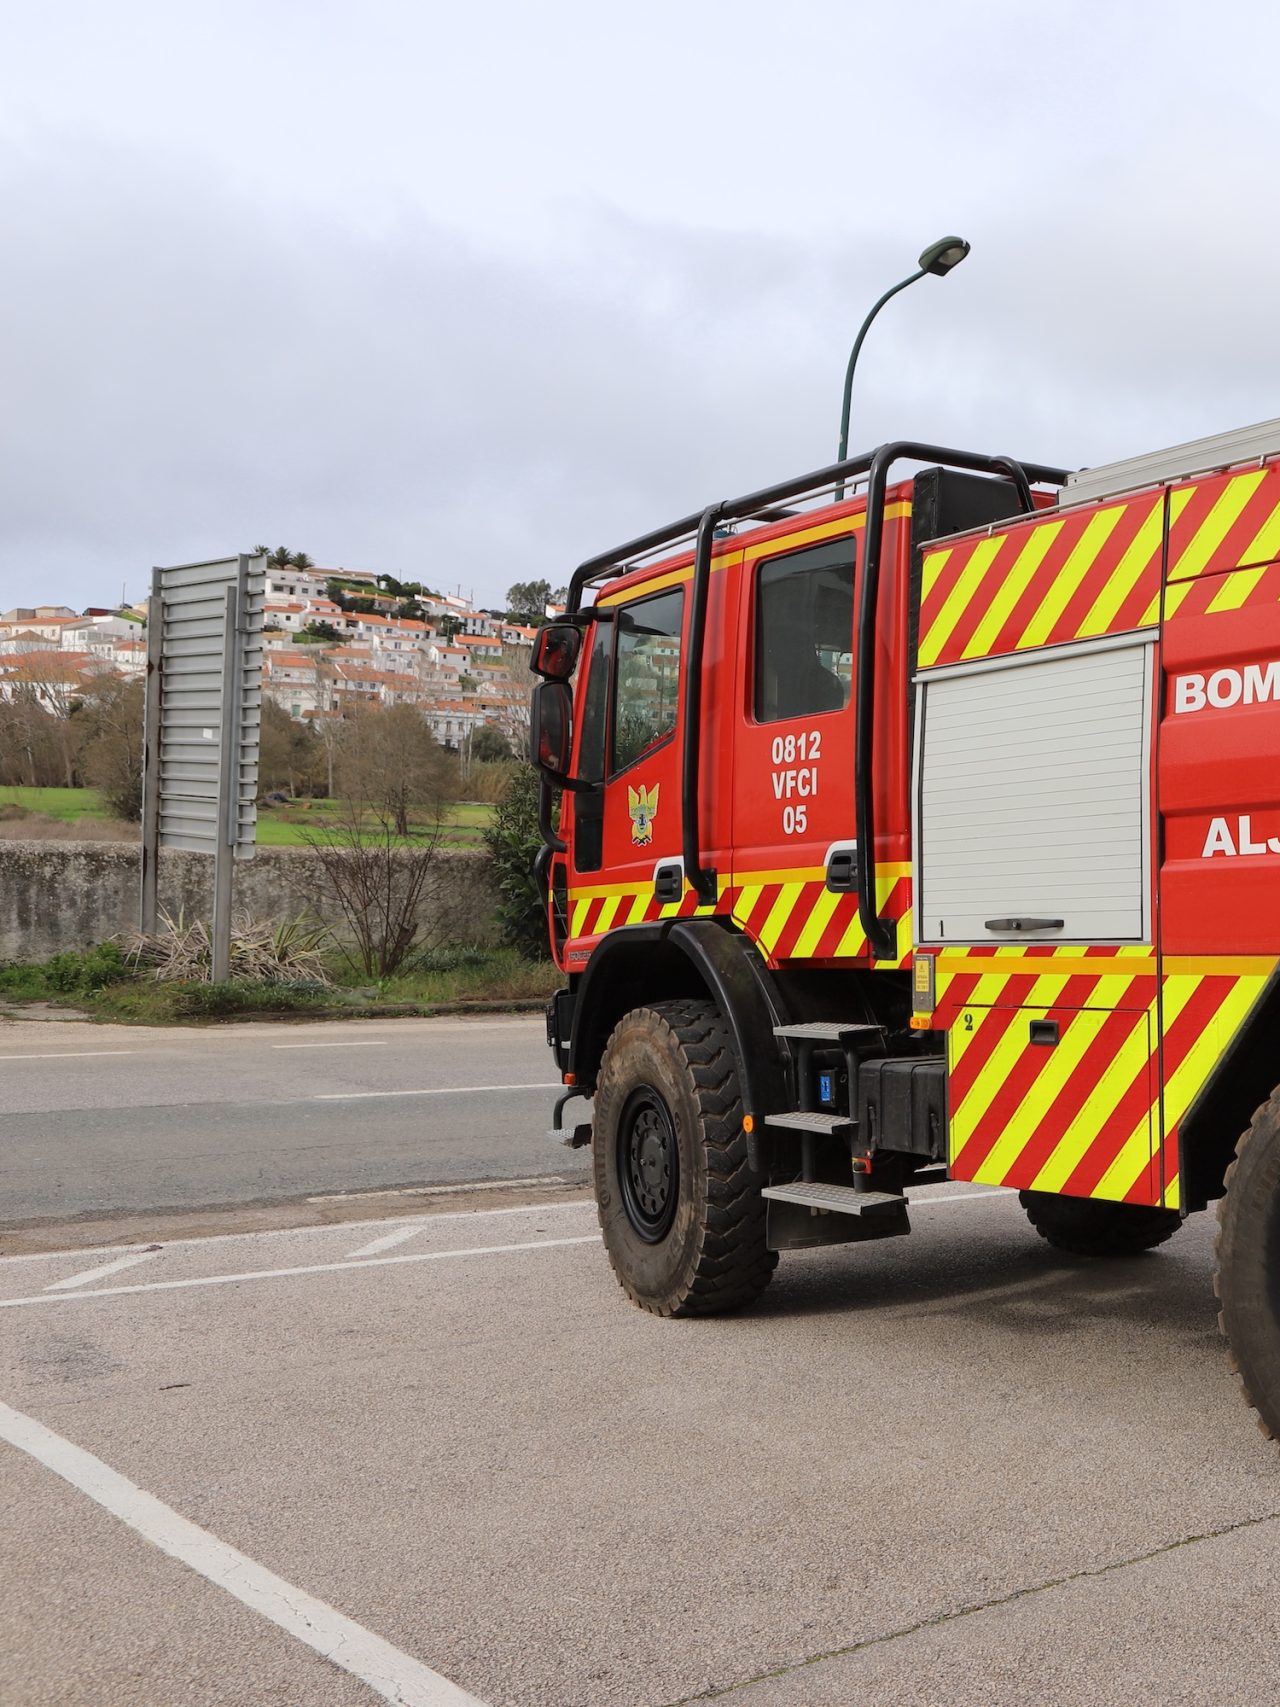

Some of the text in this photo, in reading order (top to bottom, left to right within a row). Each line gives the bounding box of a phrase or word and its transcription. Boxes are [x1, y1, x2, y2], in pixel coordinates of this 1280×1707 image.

[771, 731, 821, 765] 0812
[772, 768, 817, 800] VFCI
[783, 805, 807, 835] 05
[939, 920, 945, 937] 1
[964, 1013, 974, 1031] 2
